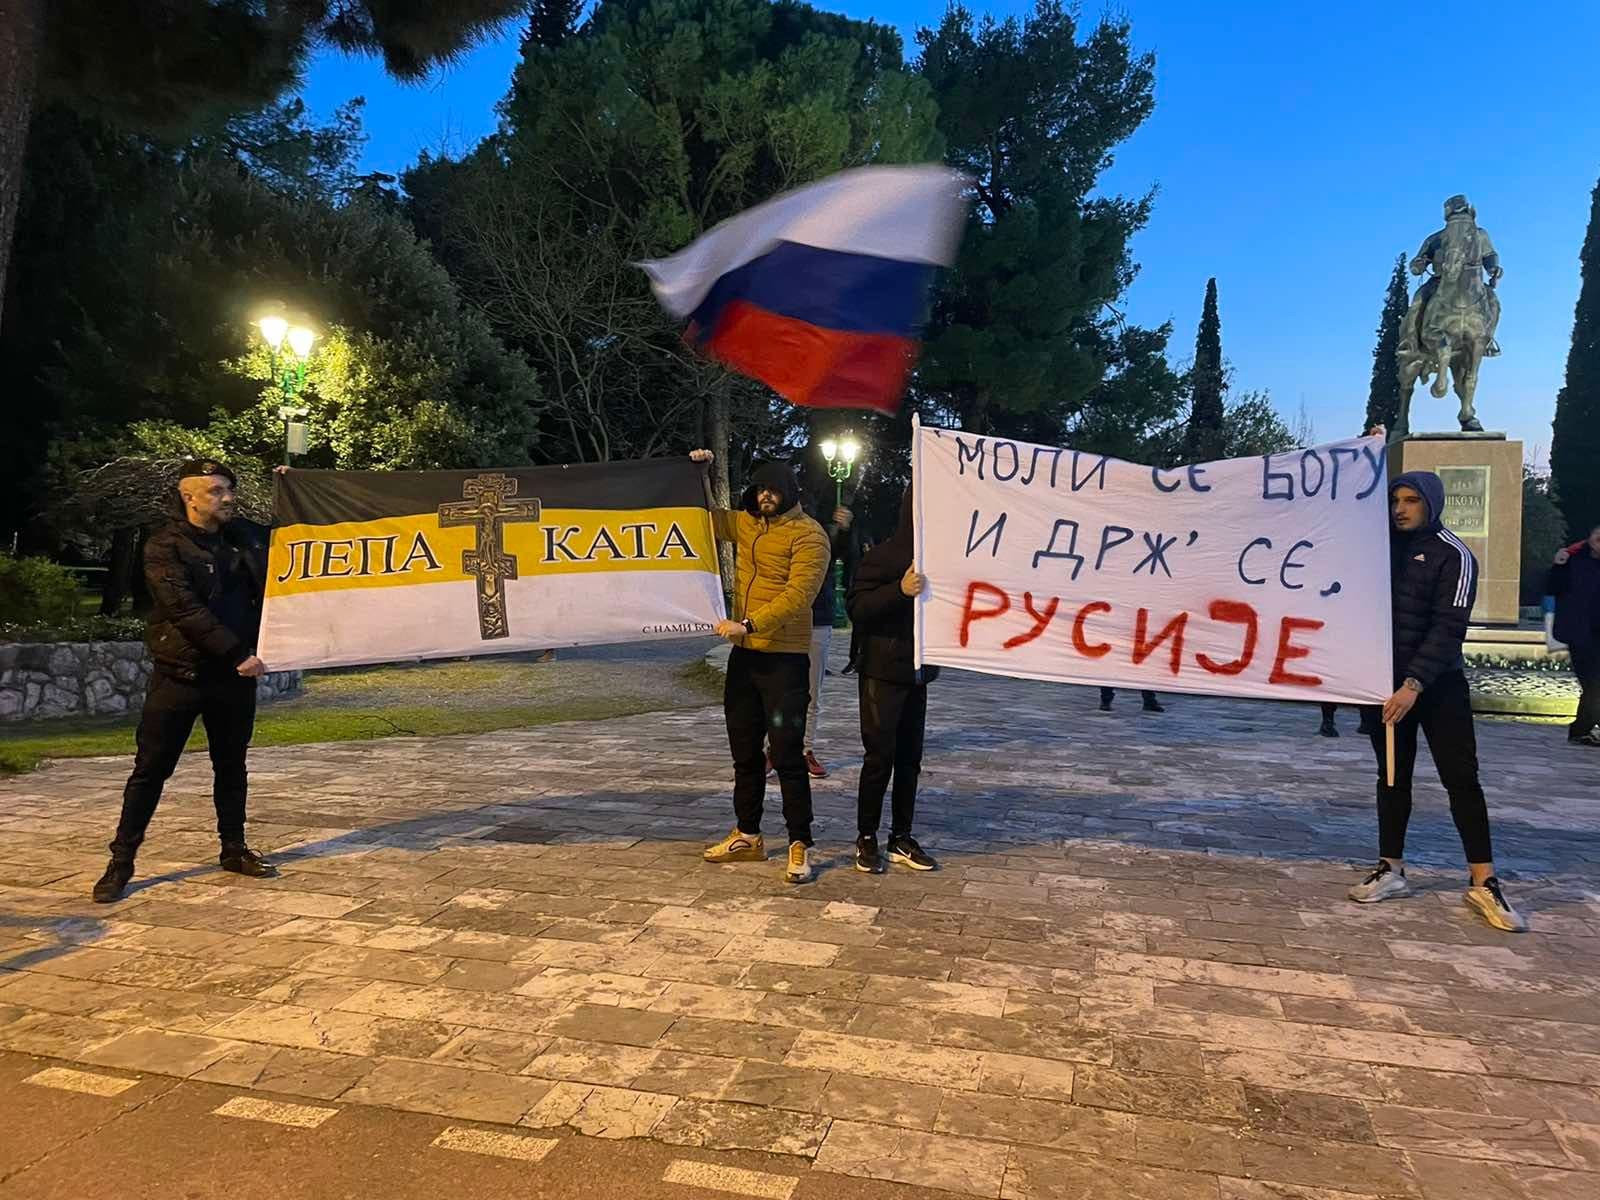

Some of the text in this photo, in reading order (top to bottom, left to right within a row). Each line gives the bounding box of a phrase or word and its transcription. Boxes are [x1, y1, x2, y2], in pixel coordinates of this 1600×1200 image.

[956, 436, 1387, 500] МОЛИ СЕ БОГУ
[277, 521, 699, 583] ЛЕПА КАТА
[965, 509, 1007, 558] И
[642, 626, 651, 634] С
[654, 623, 691, 633] НАМИ
[959, 581, 1326, 687] РУСИЈЕ
